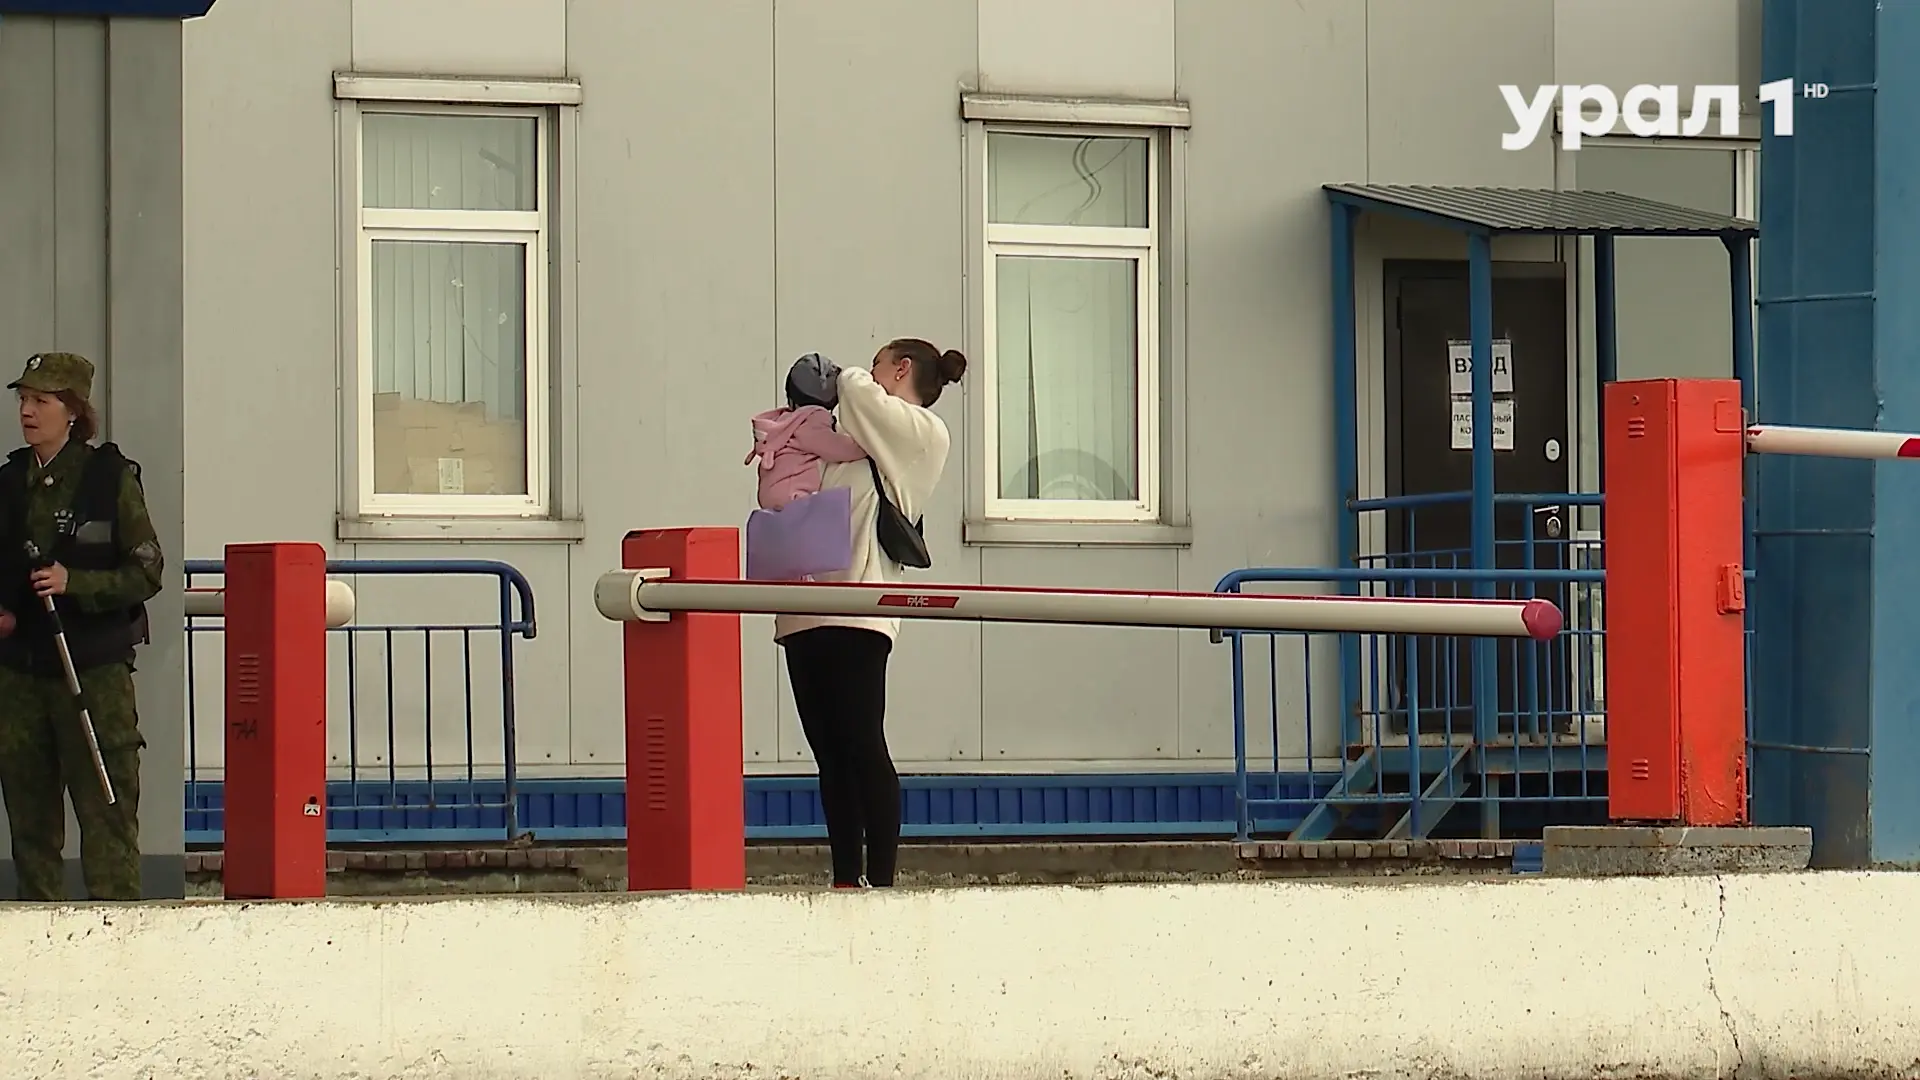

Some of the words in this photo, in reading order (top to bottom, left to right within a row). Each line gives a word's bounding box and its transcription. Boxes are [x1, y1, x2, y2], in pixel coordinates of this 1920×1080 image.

[1455, 356, 1507, 375] ВХД
[1453, 414, 1512, 423] ПАСНЫЙ
[1460, 427, 1505, 435] КОЛЬ
